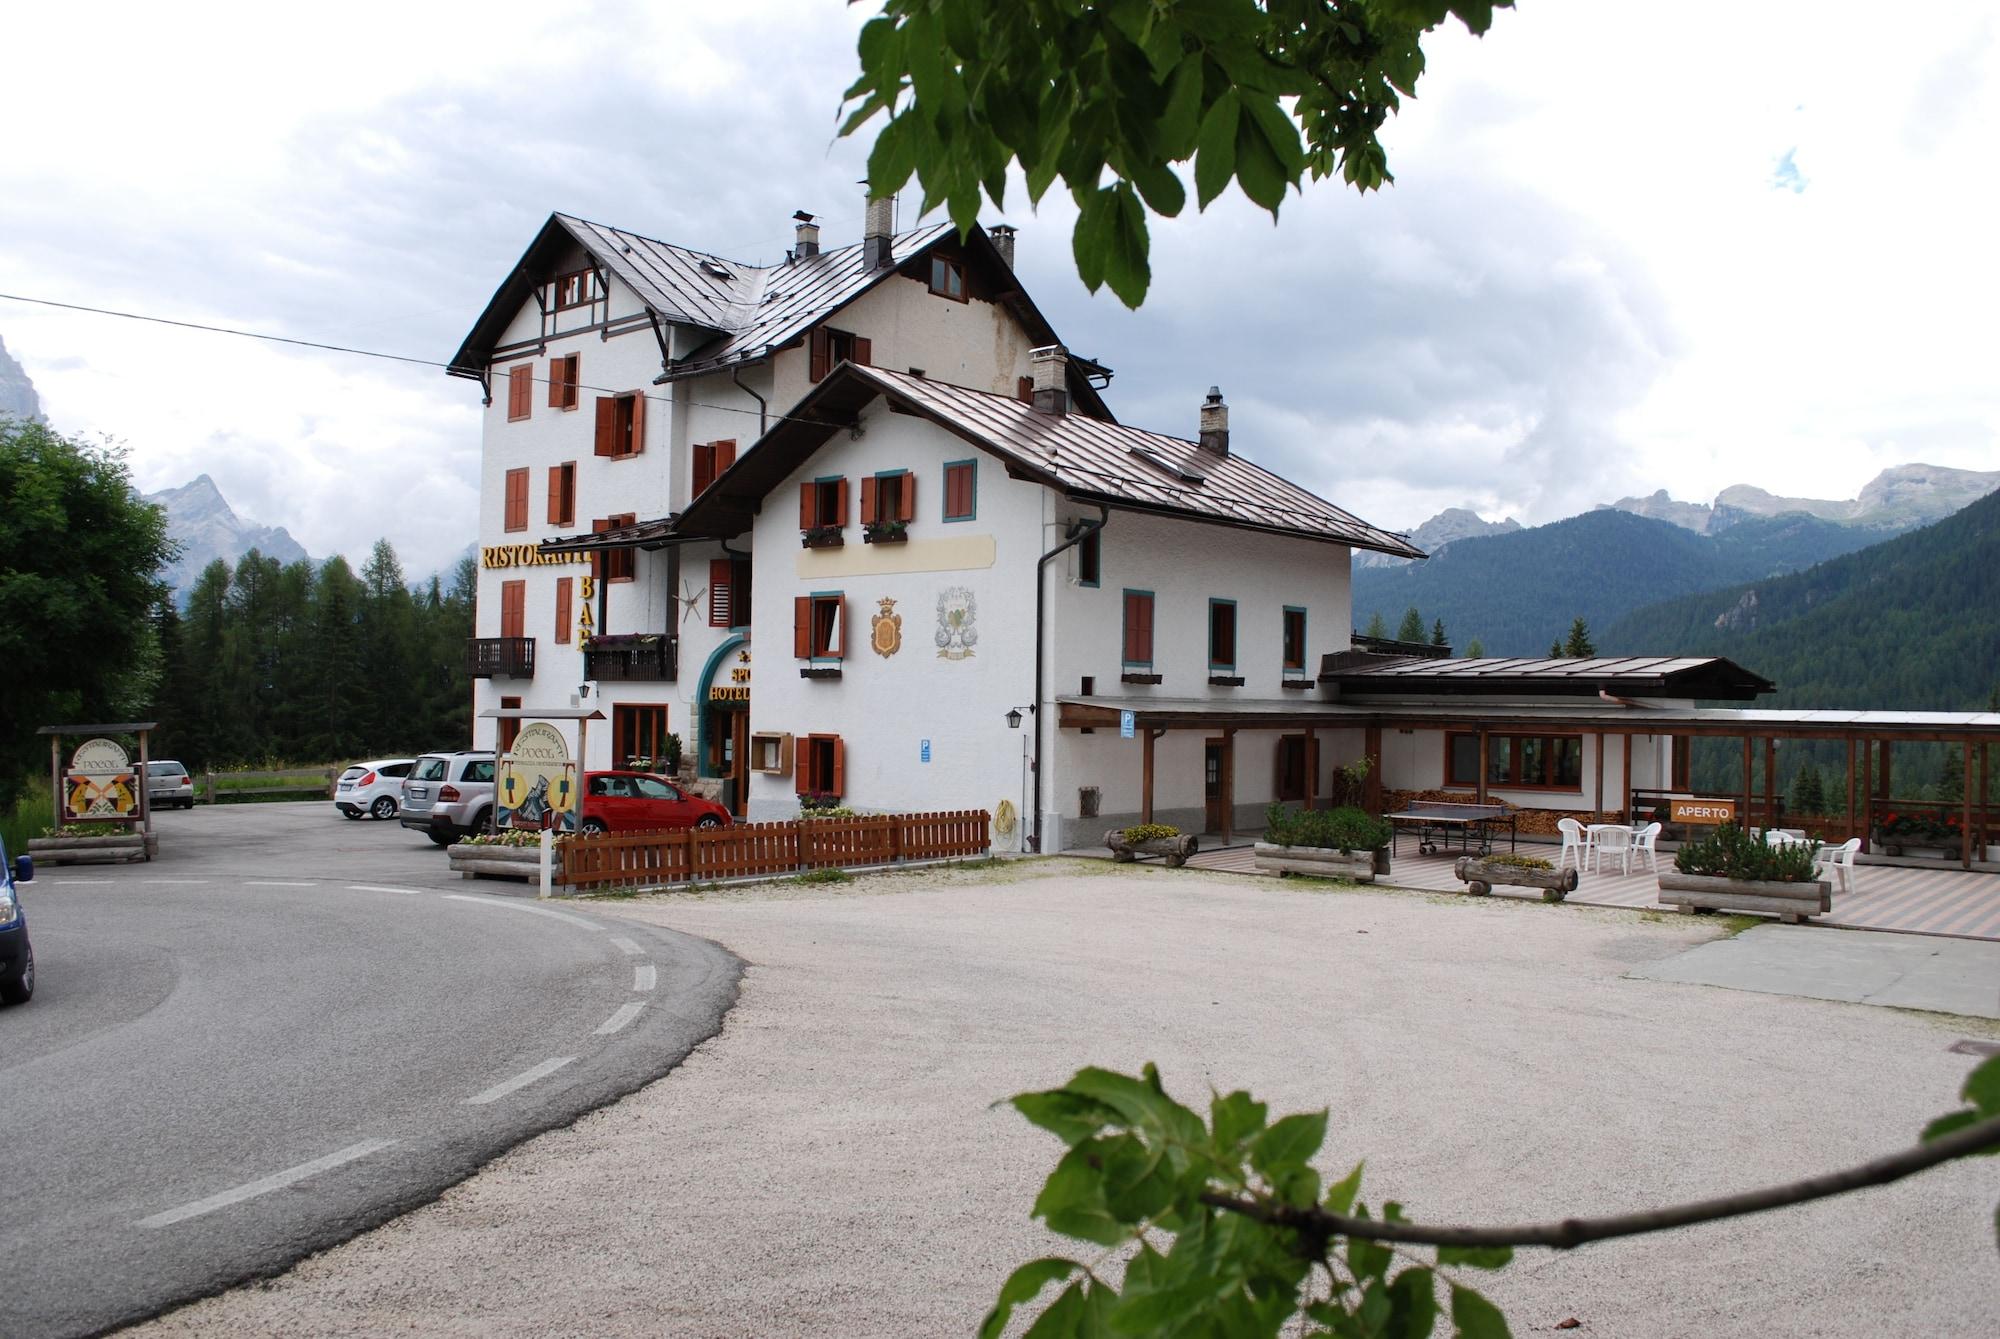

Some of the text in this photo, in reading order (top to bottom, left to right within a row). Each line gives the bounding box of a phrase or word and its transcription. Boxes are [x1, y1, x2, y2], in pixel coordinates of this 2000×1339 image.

[577, 576, 594, 652] BAR
[709, 687, 751, 701] HOTEL
[1124, 712, 1132, 723] P
[1677, 806, 1730, 819] APERTO
